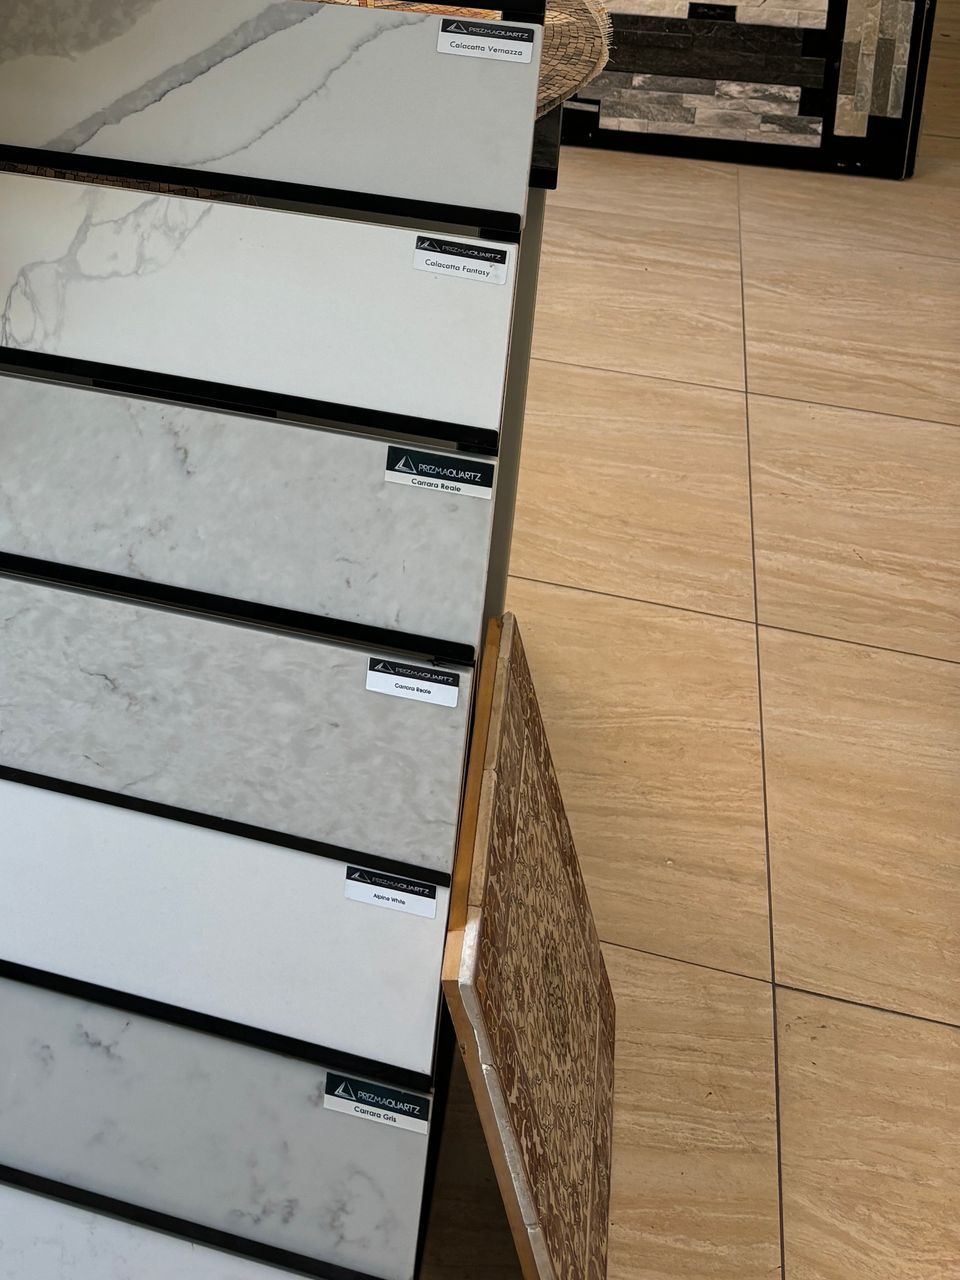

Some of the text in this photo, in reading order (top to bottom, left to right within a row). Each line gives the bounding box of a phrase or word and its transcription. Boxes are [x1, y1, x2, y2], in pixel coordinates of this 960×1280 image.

[468, 27, 529, 38] PRIZMAQUARTZ
[449, 41, 523, 56] Calacatta Vernazza
[441, 245, 503, 260] PRIZMAQUARTZ
[424, 258, 491, 278] Calacatta Fantasy
[418, 462, 482, 482] PRIZMAQUARTZ
[410, 478, 462, 493] Carrara Reale
[395, 666, 454, 683] PRIZMAQUARTZ
[394, 682, 415, 692] Carrara
[372, 877, 431, 895] PRIZMAQUARTZ
[372, 892, 406, 905] Alpine White
[357, 1090, 420, 1114] PRIZMAQUARTZ
[353, 1105, 397, 1124] Carrara Gris
